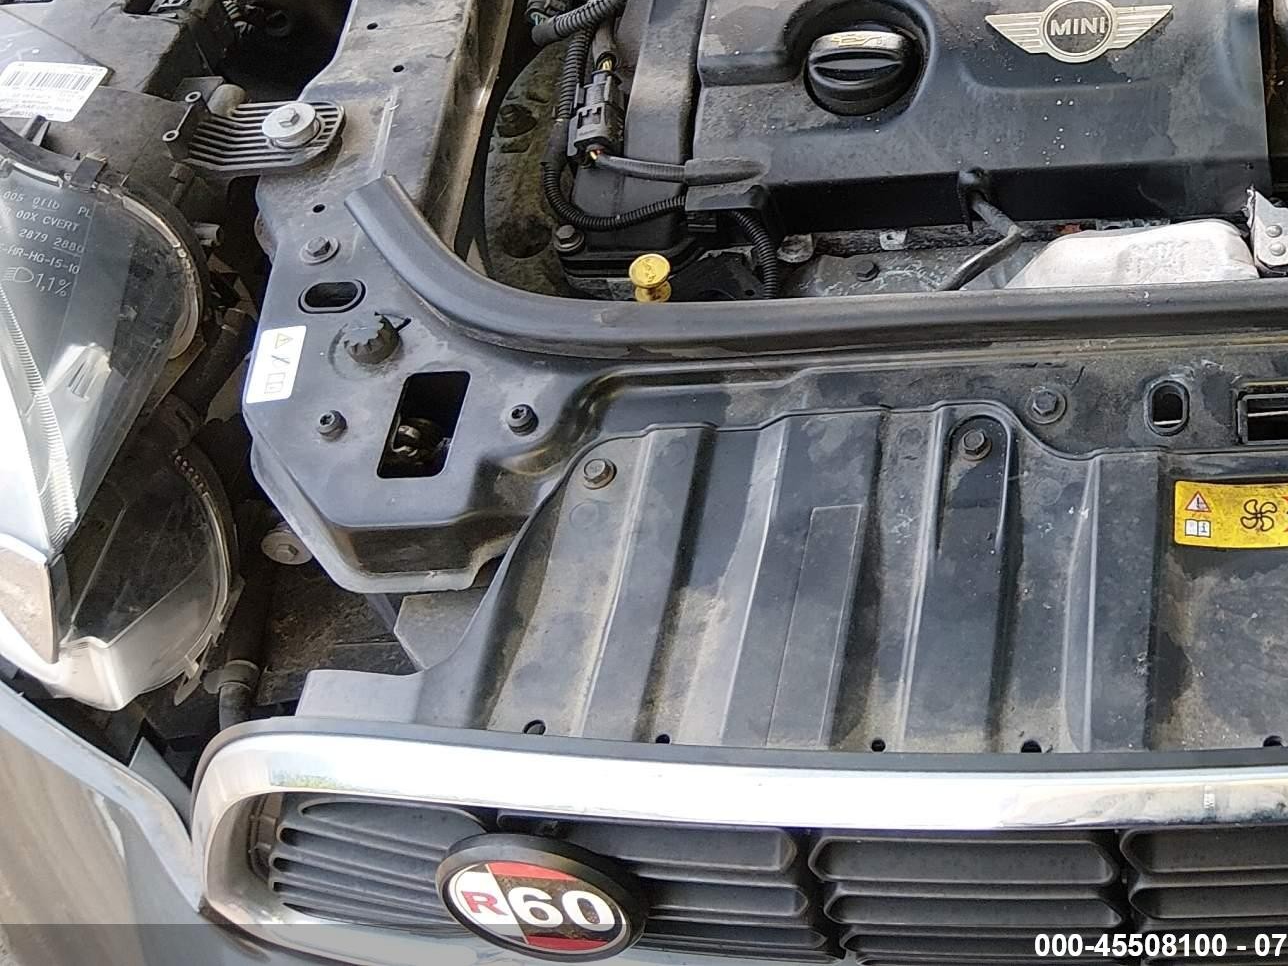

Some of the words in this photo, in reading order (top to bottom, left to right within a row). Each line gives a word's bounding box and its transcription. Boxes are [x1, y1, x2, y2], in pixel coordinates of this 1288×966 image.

[1051, 17, 1106, 36] MINI
[77, 205, 91, 219] PL
[42, 216, 81, 232] CVERT
[19, 228, 49, 243] 2879
[53, 237, 85, 254] 2880
[460, 886, 616, 932] R60
